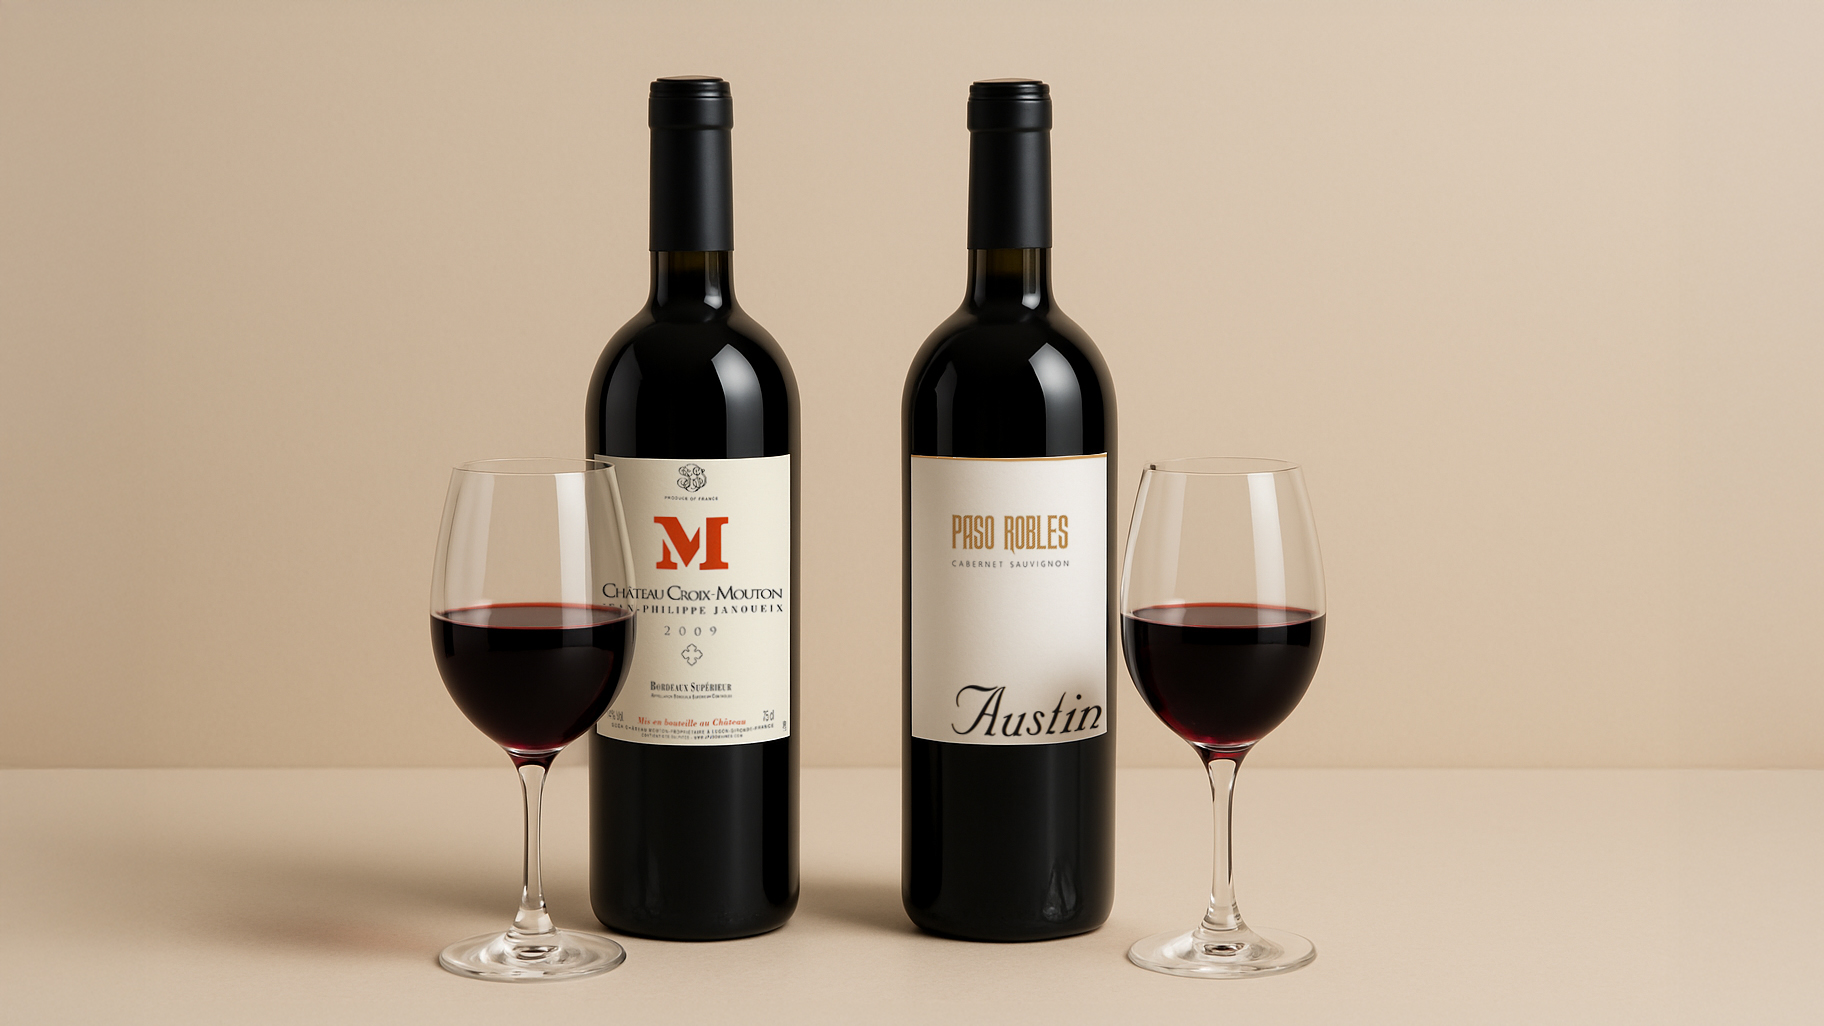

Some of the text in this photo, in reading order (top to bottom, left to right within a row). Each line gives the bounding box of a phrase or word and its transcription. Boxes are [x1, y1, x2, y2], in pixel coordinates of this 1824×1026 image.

[952, 514, 1069, 555] PASO ROBLES
[653, 516, 729, 570] M
[951, 560, 1070, 569] CABERNET SAUVIGNON
[602, 582, 783, 602] CHÂTEAU CROIX-MOUTON
[713, 604, 783, 615] JANOUEIX
[664, 625, 717, 637] 2009
[650, 681, 688, 692] BORDEAUX
[951, 684, 1102, 737] Austin
[637, 716, 650, 725] Mis
[664, 718, 697, 728] bouteille
